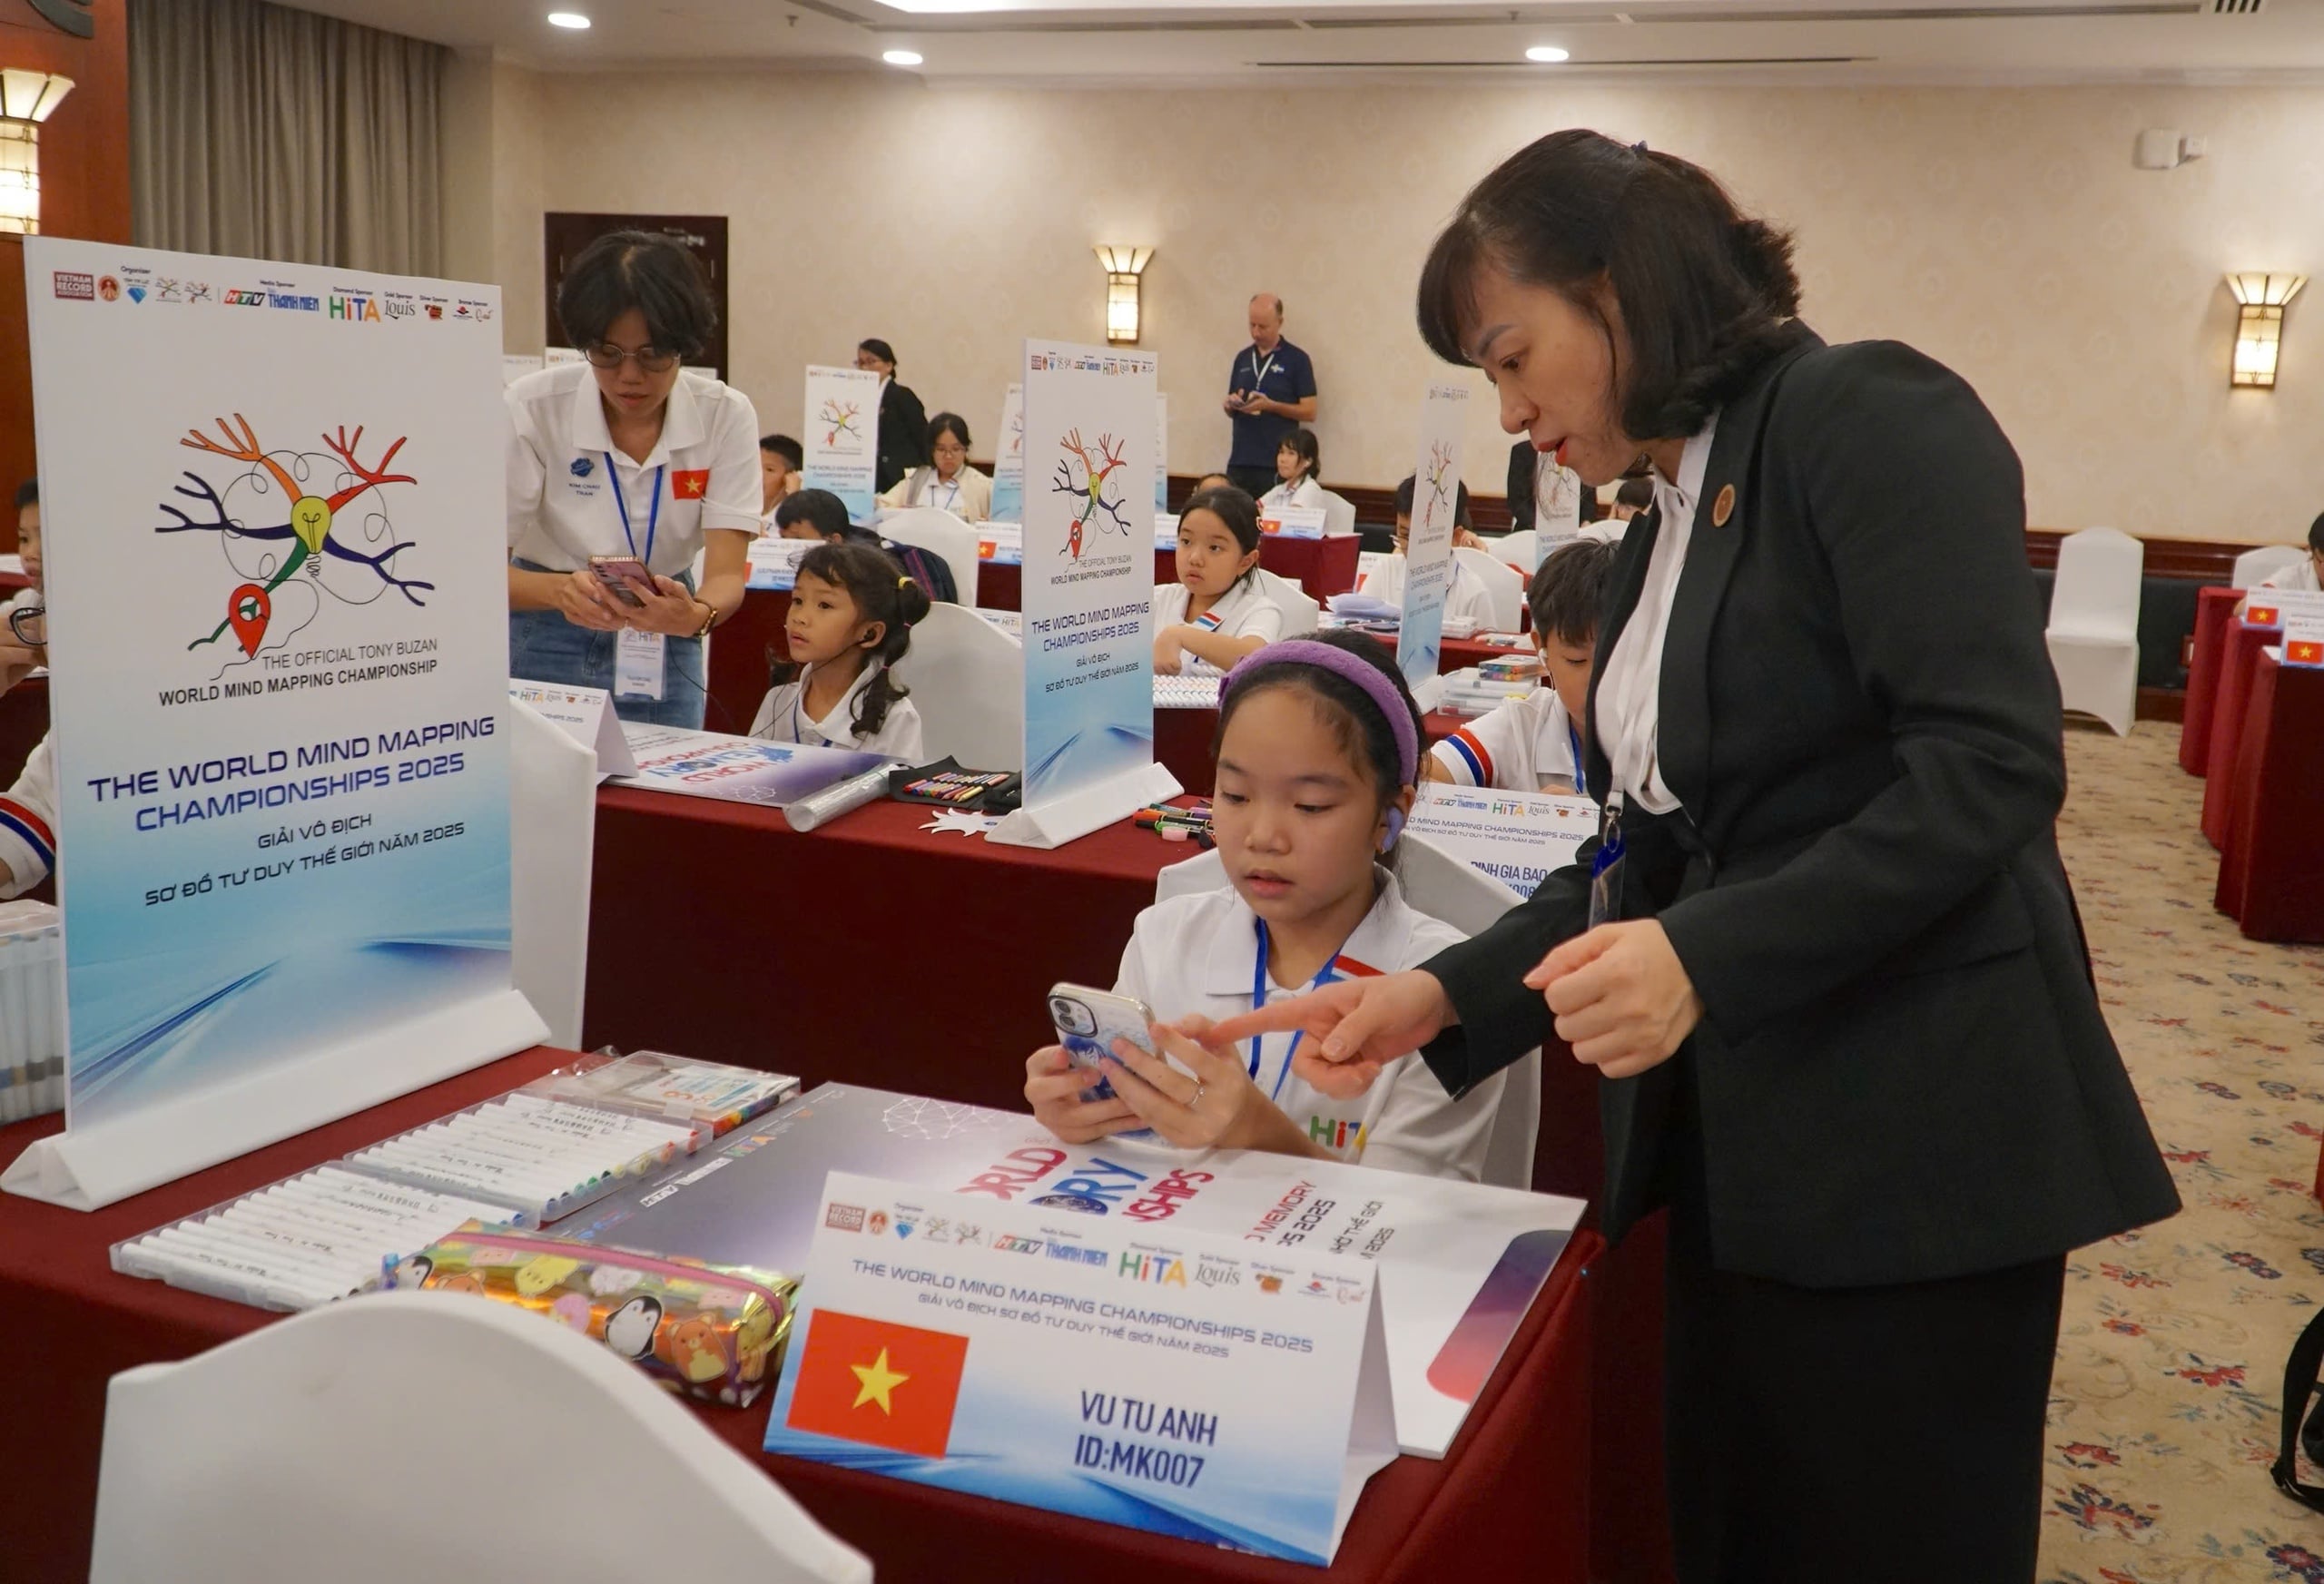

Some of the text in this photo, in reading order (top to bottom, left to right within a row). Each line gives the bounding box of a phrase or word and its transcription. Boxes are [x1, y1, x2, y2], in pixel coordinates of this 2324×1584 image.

[56, 281, 92, 292] RECORD
[224, 290, 265, 306] HTV
[268, 293, 299, 310] THANH
[330, 296, 380, 323] HiTA
[384, 300, 416, 320] Louis
[1031, 602, 1149, 635] THE WORLD MIND MAPPING
[1044, 621, 1139, 652] CHAMPIONSHIPS 2025
[262, 638, 438, 671] THE OFFICIAL TONY BUZAN
[159, 659, 438, 706] WORLD MIND MAPPING CHAMPIONSHIP
[87, 716, 495, 802] THE WORLD MIND MAPPING
[135, 752, 465, 831] CHAMPIONSHIPS 2025
[1492, 802, 1525, 817] HiTA
[1528, 806, 1550, 816] Louis
[258, 813, 372, 849] GIẢI VÔ ĐỊCH
[1416, 817, 1440, 826] MIND
[1442, 821, 1482, 831] MAPPING
[1484, 824, 1558, 839] CHAMPIONSHIPS
[1560, 832, 1584, 841] 2025
[145, 822, 465, 906] SƠ ĐỒ TƯ DUY THẾ GIỚI NĂM 2025
[1500, 864, 1520, 880] GIA
[1522, 867, 1548, 881] BAO
[830, 1214, 862, 1225] RECORD
[1253, 1180, 1316, 1234] MEMORY
[1292, 1199, 1336, 1232] 2025
[995, 1235, 1043, 1254] HTV
[1045, 1242, 1082, 1263] THANH
[1365, 1227, 1395, 1253] 2025
[1118, 1251, 1187, 1288] HiTA
[1195, 1264, 1241, 1288] Louis
[853, 1259, 1315, 1353] THE WORLD MIND MAPPING CHAMPIONSHIPS 2025
[918, 1293, 942, 1306] GIẢI
[946, 1297, 963, 1310] VÔ
[967, 1303, 996, 1316] ĐỊCH
[1000, 1307, 1019, 1320] SƠ
[1045, 1316, 1065, 1328] TƯ
[1067, 1320, 1095, 1333] DUY
[1099, 1325, 1126, 1340] THẾ
[1192, 1343, 1230, 1358] 2025
[1081, 1390, 1218, 1447] VU TU ANH
[1074, 1434, 1206, 1489] ID:MK007
